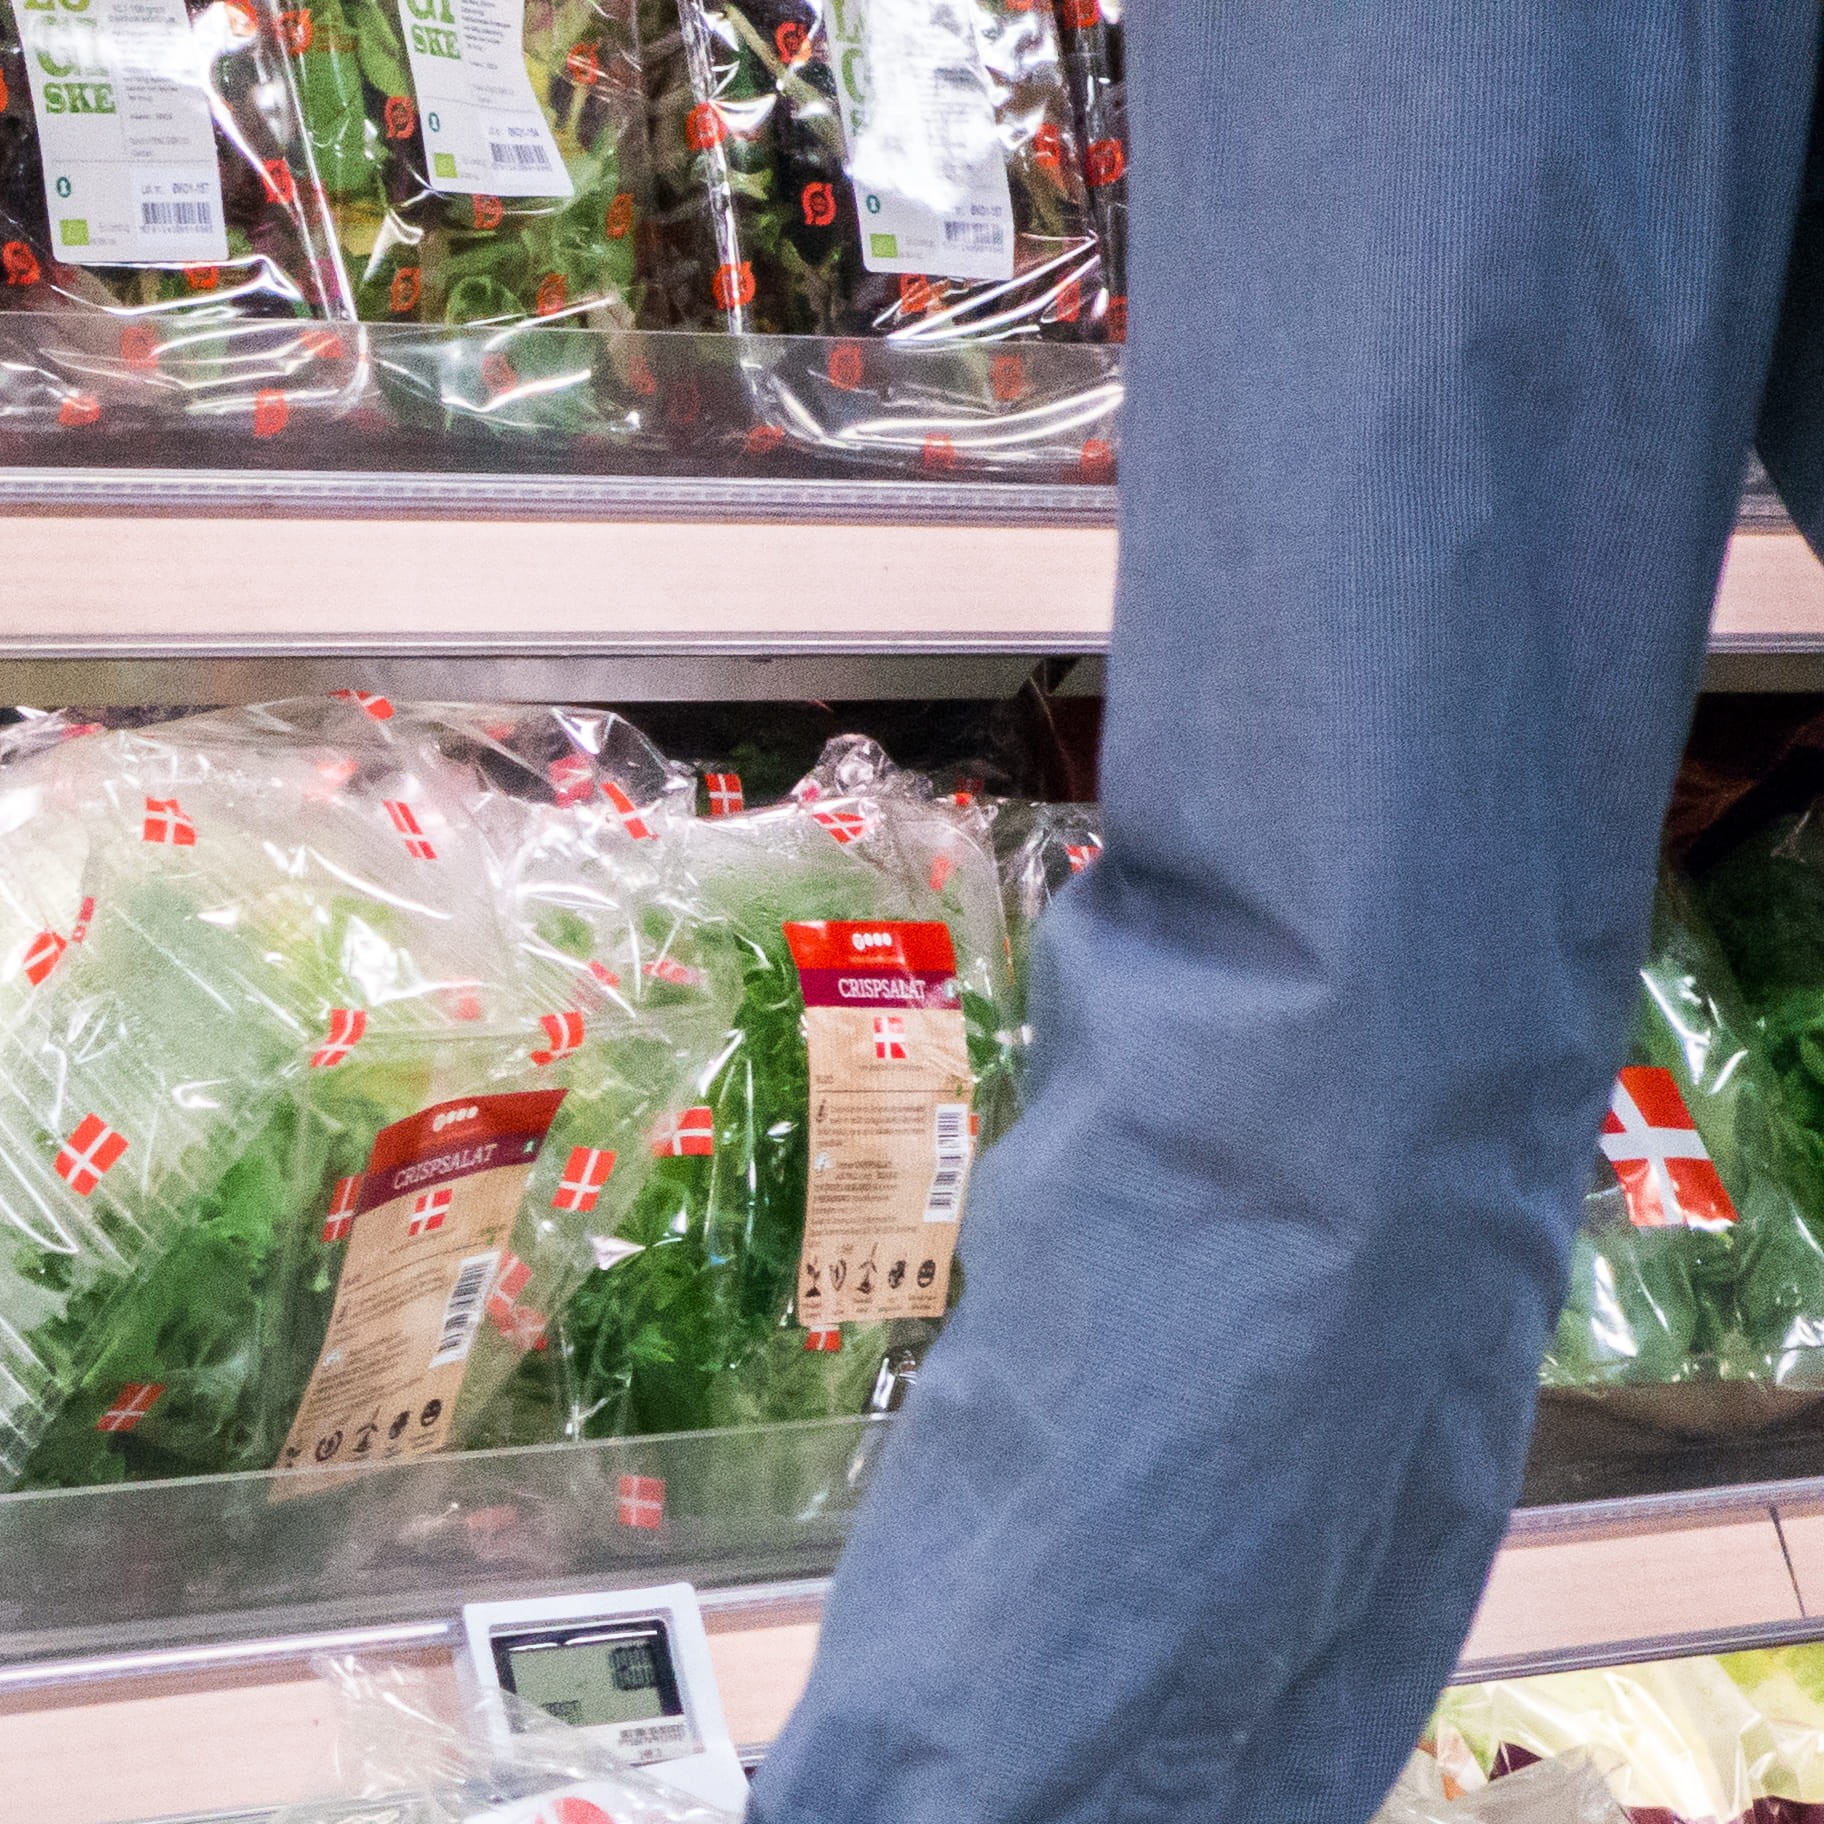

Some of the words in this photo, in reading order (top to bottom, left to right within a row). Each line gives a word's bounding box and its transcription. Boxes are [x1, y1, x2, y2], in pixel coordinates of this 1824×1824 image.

[43, 82, 117, 114] SKE
[838, 978, 926, 1000] CRISPSALAT
[393, 1143, 497, 1189] CRISPSALAT
